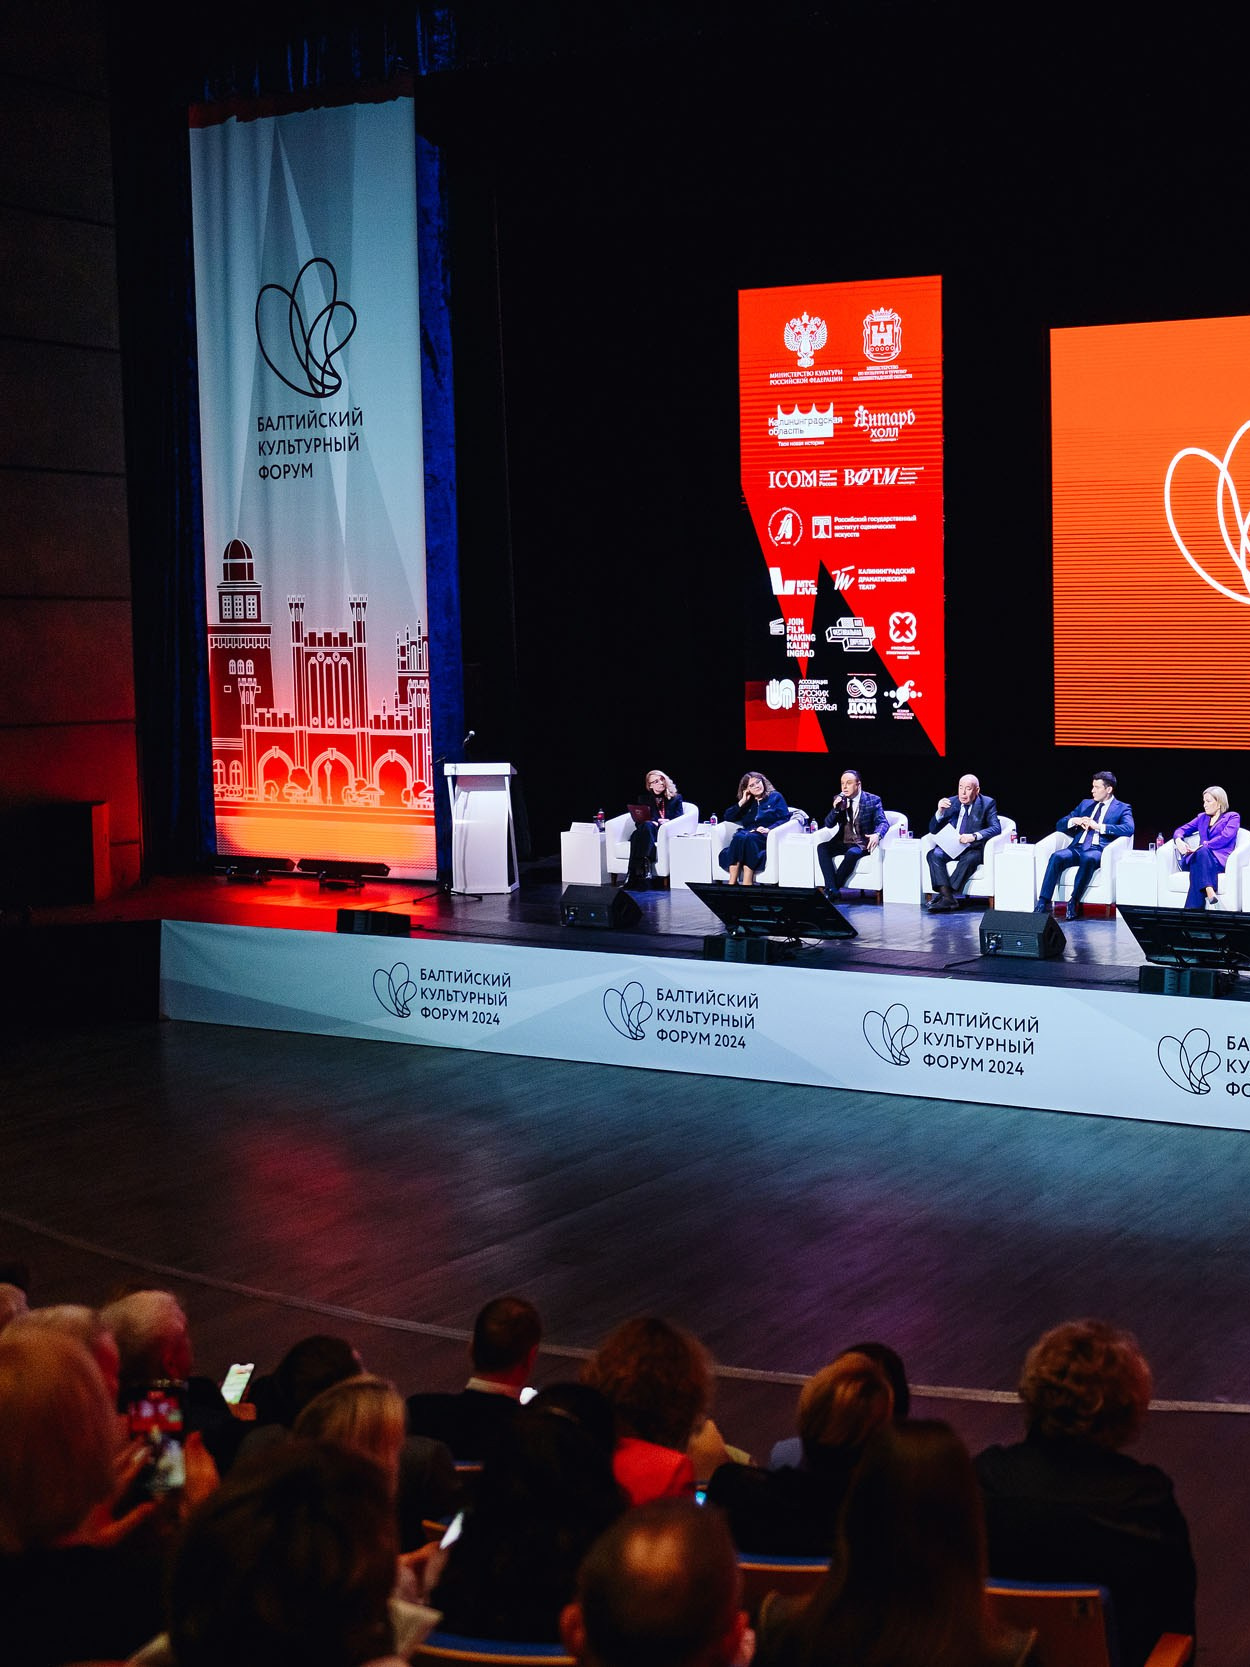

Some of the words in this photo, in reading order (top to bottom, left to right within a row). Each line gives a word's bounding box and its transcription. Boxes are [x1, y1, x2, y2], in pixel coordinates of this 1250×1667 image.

[769, 371, 814, 379] МИНИСТЕРСТВО
[769, 377, 808, 386] РОССИЙСКОЙ
[257, 407, 363, 432] БАЛТИЙСКИЙ
[870, 427, 899, 438] ХОЛЛ
[258, 432, 359, 456] КУЛЬТУРНЫЙ
[259, 463, 313, 480] ФОРУМ
[768, 470, 817, 488] ICOM
[844, 467, 900, 486] ВФТМ
[796, 587, 818, 595] LIVE
[787, 618, 804, 626] JOIN
[787, 626, 805, 634] FILM
[786, 642, 810, 650] KALIN
[787, 633, 816, 642] MAKING
[787, 650, 815, 658] INGRAD
[847, 702, 877, 715] ДОМ
[420, 968, 511, 988] БАЛТИЙСКИЙ
[421, 987, 507, 1007] КУЛЬТУРНЫЙ
[656, 988, 759, 1009] БАЛТИЙСКИЙ
[421, 1006, 468, 1022] ФОРУМ
[472, 1011, 500, 1025] 2024
[657, 1008, 755, 1029] КУЛЬТУРНЫЙ
[923, 1010, 1039, 1034] БАЛТИЙСКИЙ
[656, 1028, 710, 1045] ФОРУМ
[714, 1033, 746, 1049] 2024
[923, 1031, 1034, 1055] КУЛЬТУРНЫЙ
[923, 1053, 984, 1072] ФОРУМ
[988, 1059, 1024, 1076] 2024
